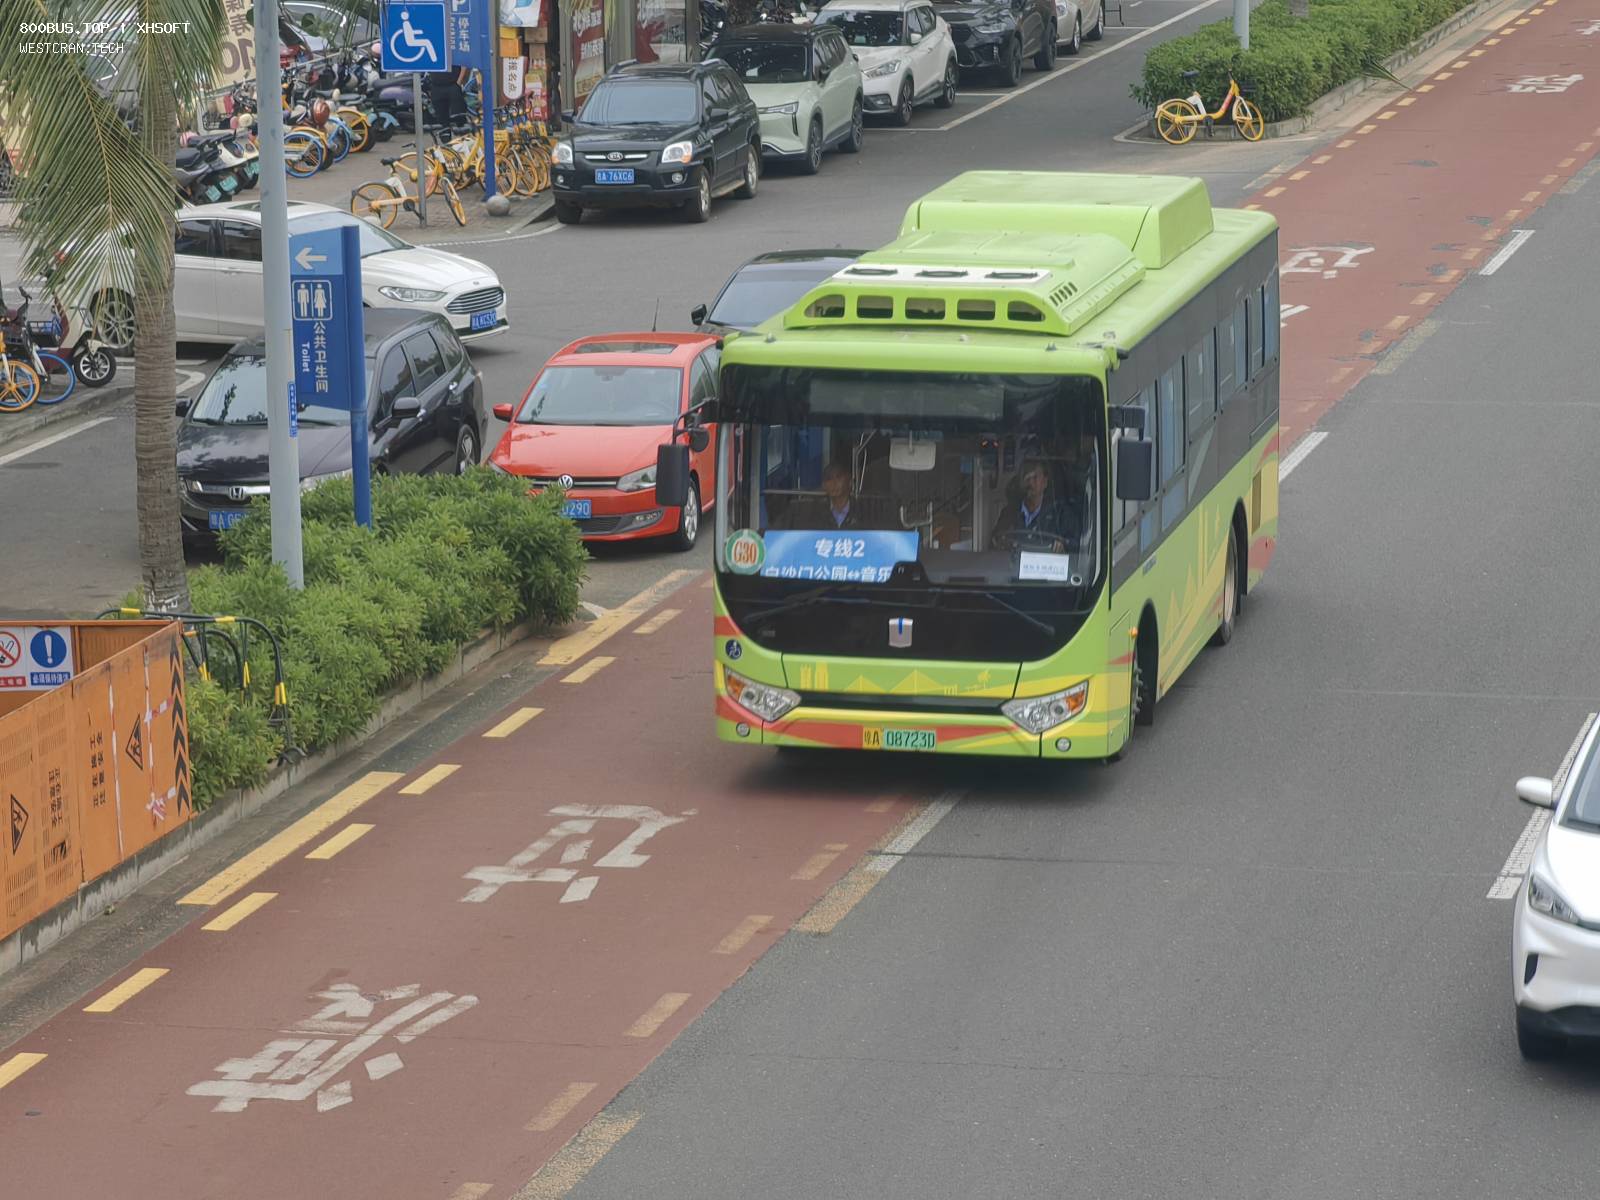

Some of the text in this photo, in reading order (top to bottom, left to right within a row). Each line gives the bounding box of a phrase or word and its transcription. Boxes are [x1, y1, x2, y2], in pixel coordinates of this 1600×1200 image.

[301, 341, 311, 373] Toilet
[313, 321, 329, 393] 公共卫生间
[733, 540, 758, 564] G30
[815, 538, 865, 558] 专线2
